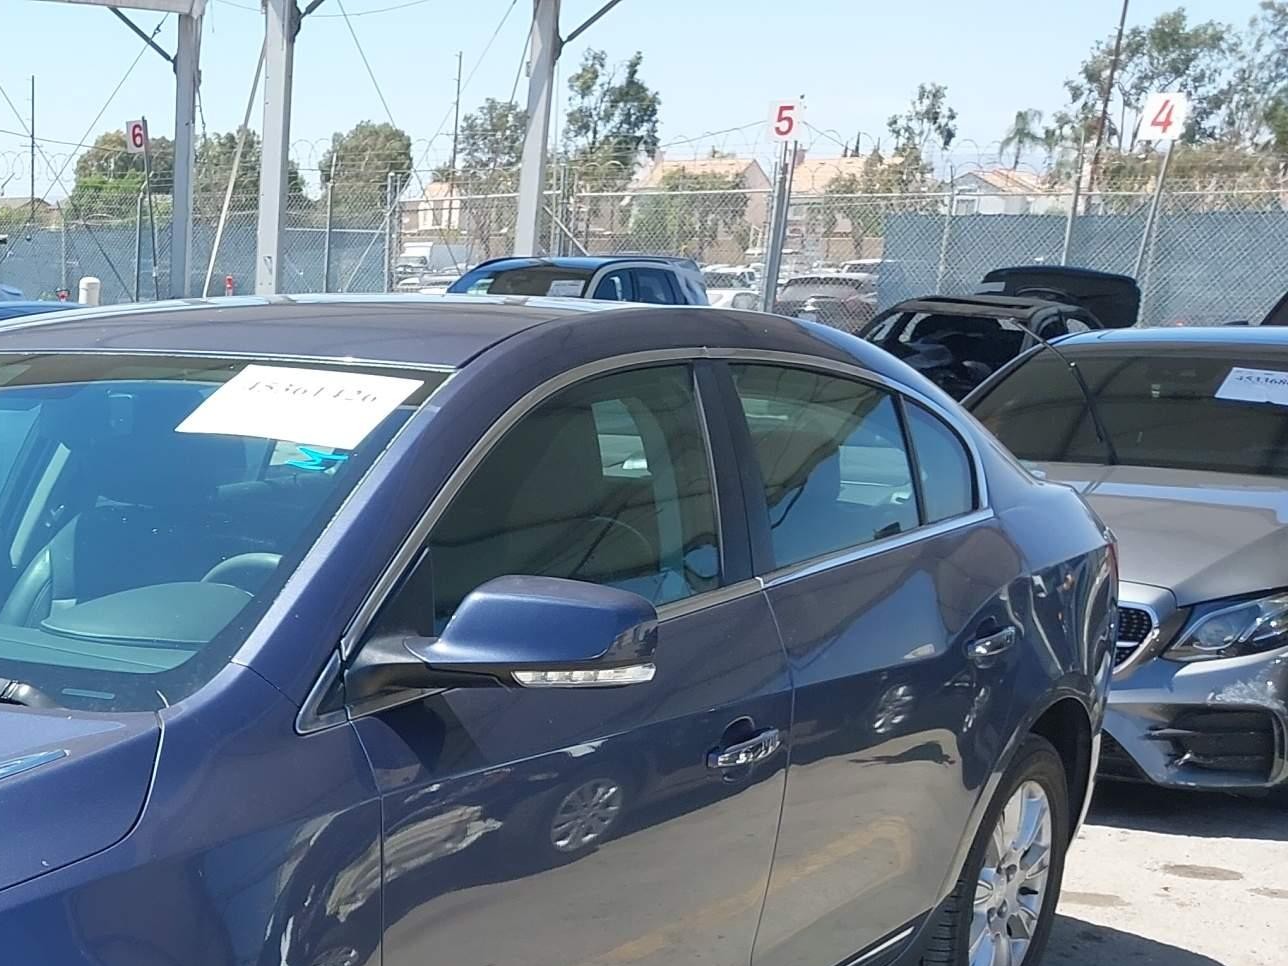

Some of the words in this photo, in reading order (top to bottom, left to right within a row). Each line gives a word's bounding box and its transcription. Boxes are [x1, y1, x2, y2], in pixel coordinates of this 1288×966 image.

[774, 105, 795, 136] 5
[1150, 99, 1175, 134] 4
[131, 123, 144, 149] 6
